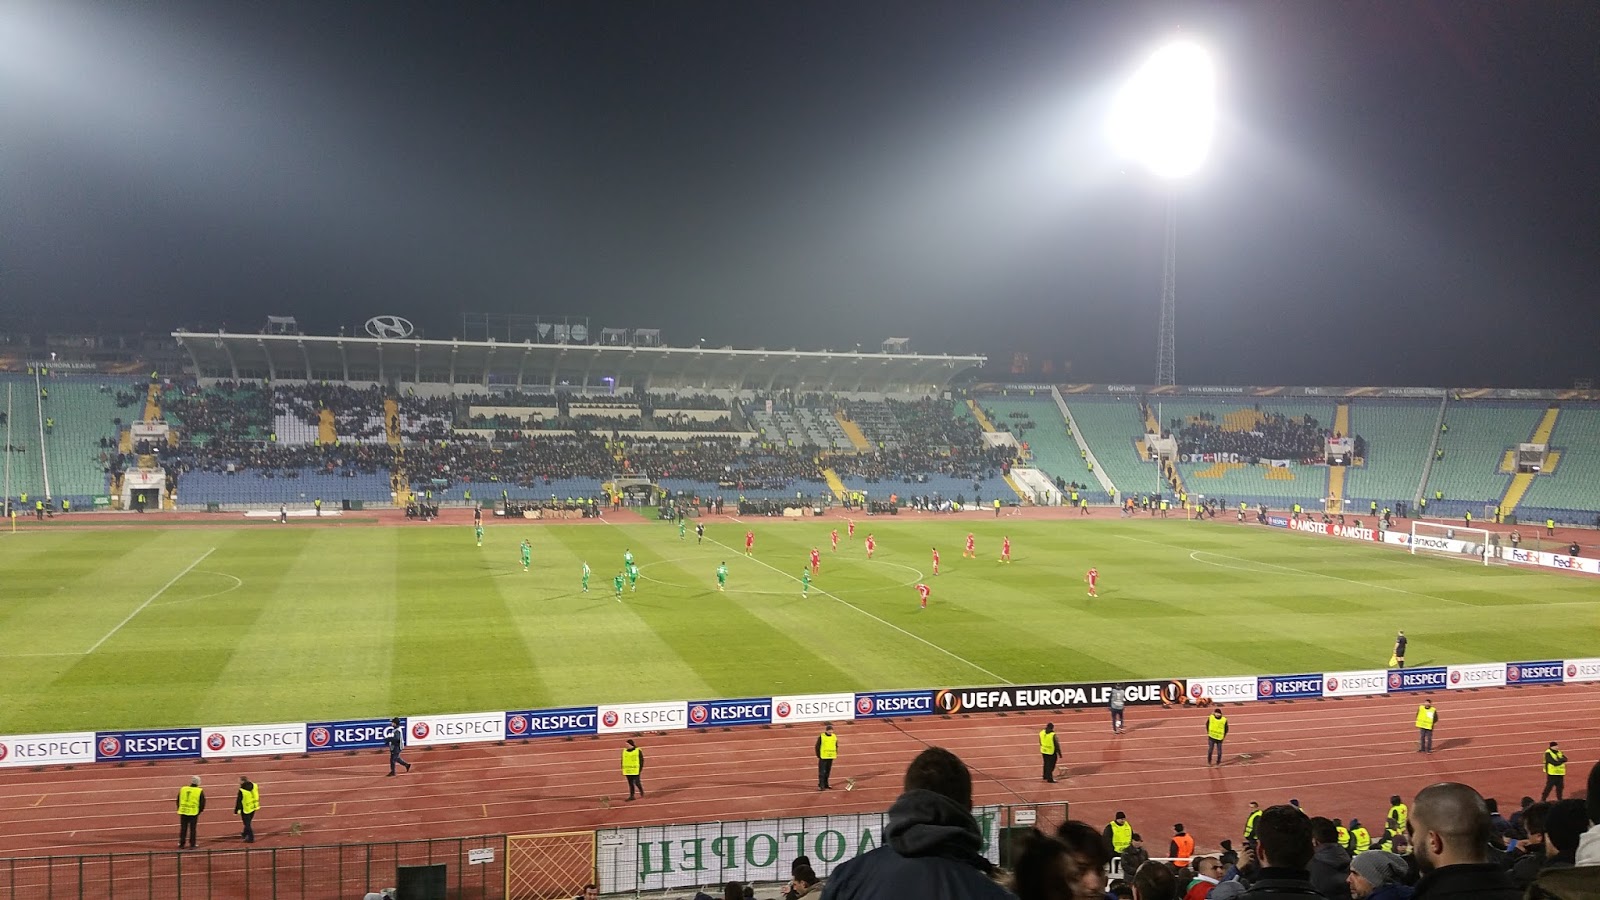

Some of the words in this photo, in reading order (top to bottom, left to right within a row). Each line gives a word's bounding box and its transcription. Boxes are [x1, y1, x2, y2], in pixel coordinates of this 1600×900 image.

[1297, 520, 1328, 534] AMSTEL
[1341, 526, 1375, 541] AMSTEL
[1413, 537, 1450, 549] ankook
[1512, 549, 1540, 563] FedEx
[1553, 555, 1583, 570] FedEx
[1463, 669, 1504, 681] RESPECT
[1521, 666, 1563, 678] RESPECT
[1580, 664, 1600, 675] RES
[1275, 679, 1323, 693] RESPECT
[1341, 677, 1386, 689] RESPECT
[1403, 673, 1447, 686] RESPECT
[1206, 683, 1255, 696] RESPECT
[876, 696, 932, 711] RESPECT
[961, 690, 1012, 710] UEFA
[1016, 687, 1088, 707] EUROPA
[1091, 684, 1161, 704] LEGUE
[711, 704, 771, 720] RESPECT
[795, 701, 852, 715] RESPECT
[531, 714, 597, 730] RESPECT
[623, 709, 685, 724] RESPECT
[435, 720, 502, 736] RESPECT
[125, 736, 200, 753] RESPECT
[231, 732, 303, 747] RESPECT
[14, 741, 92, 758] RESPECT
